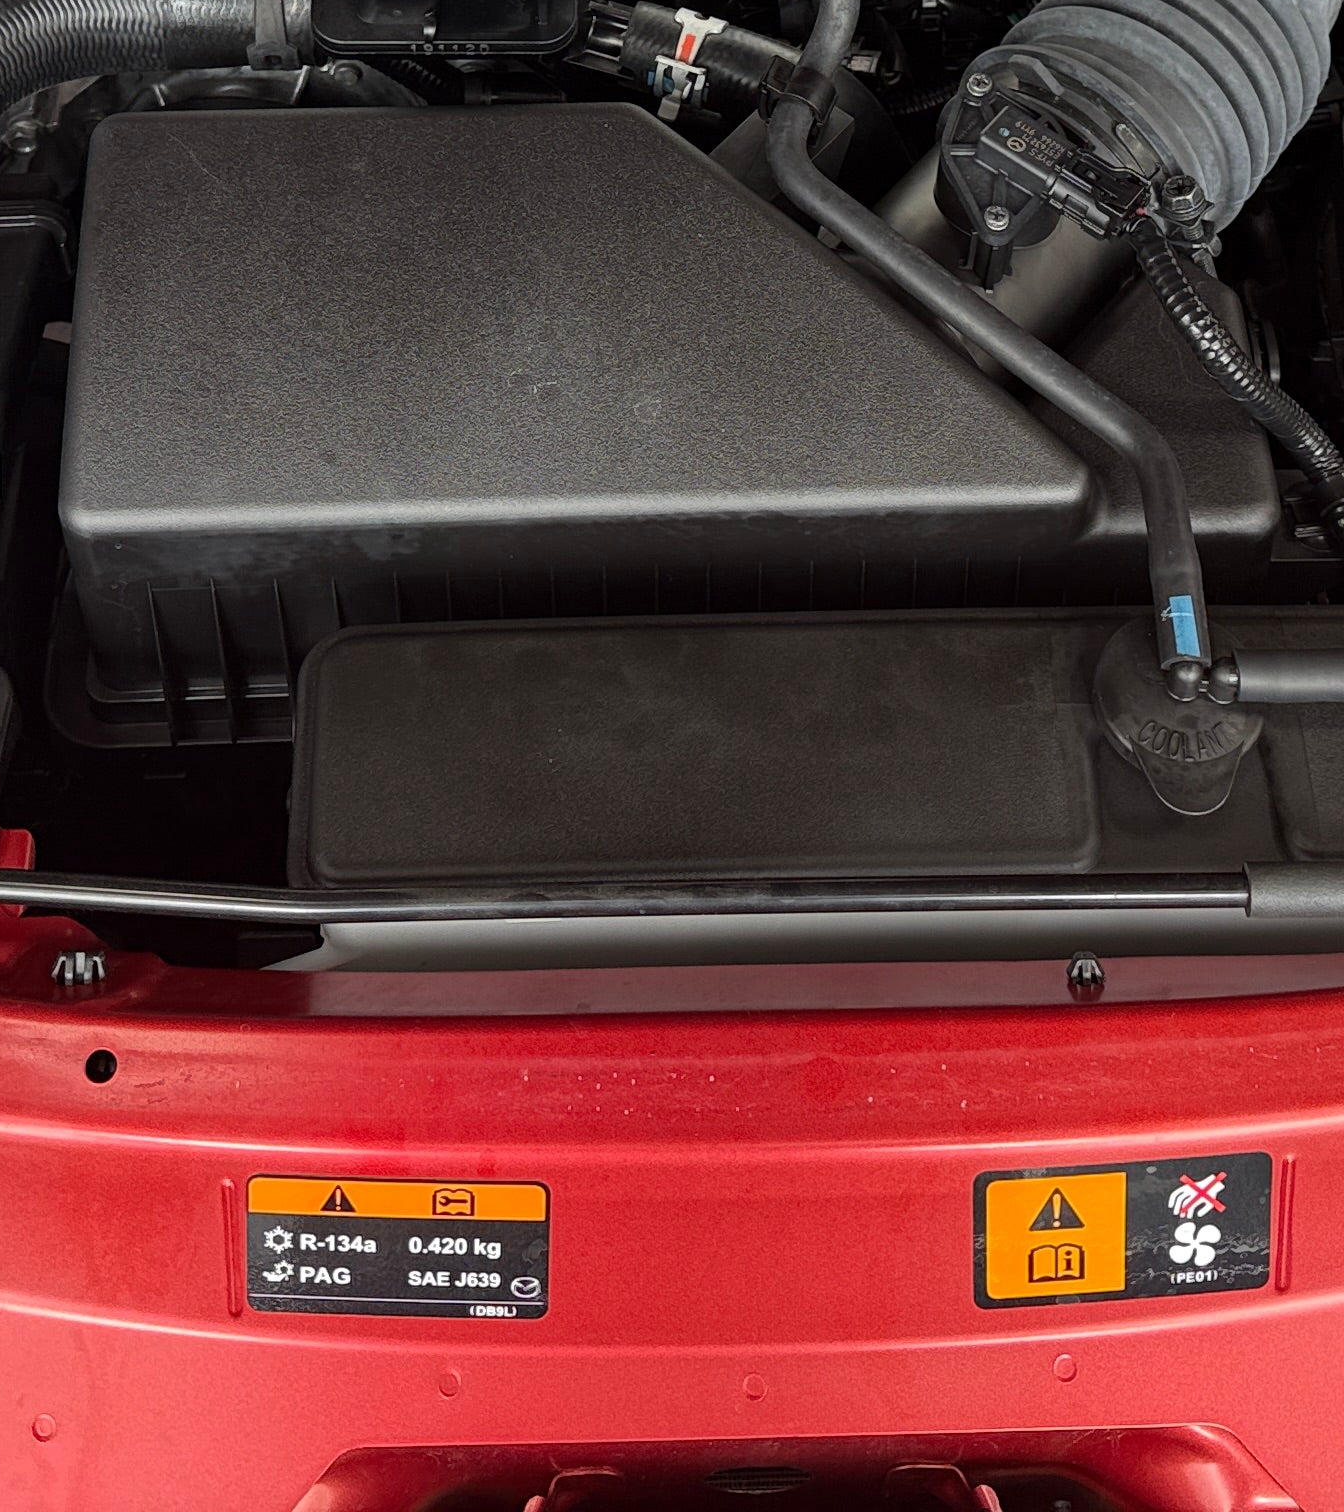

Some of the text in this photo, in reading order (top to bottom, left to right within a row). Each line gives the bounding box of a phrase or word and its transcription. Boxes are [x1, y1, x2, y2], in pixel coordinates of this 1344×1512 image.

[1138, 719, 1237, 763] COOLANT
[299, 1233, 502, 1259] R-134a 0.420 kg
[299, 1267, 501, 1288] PAG SAE J639
[1170, 1270, 1218, 1285] (PE01)
[469, 1305, 517, 1318] (DB9L)
